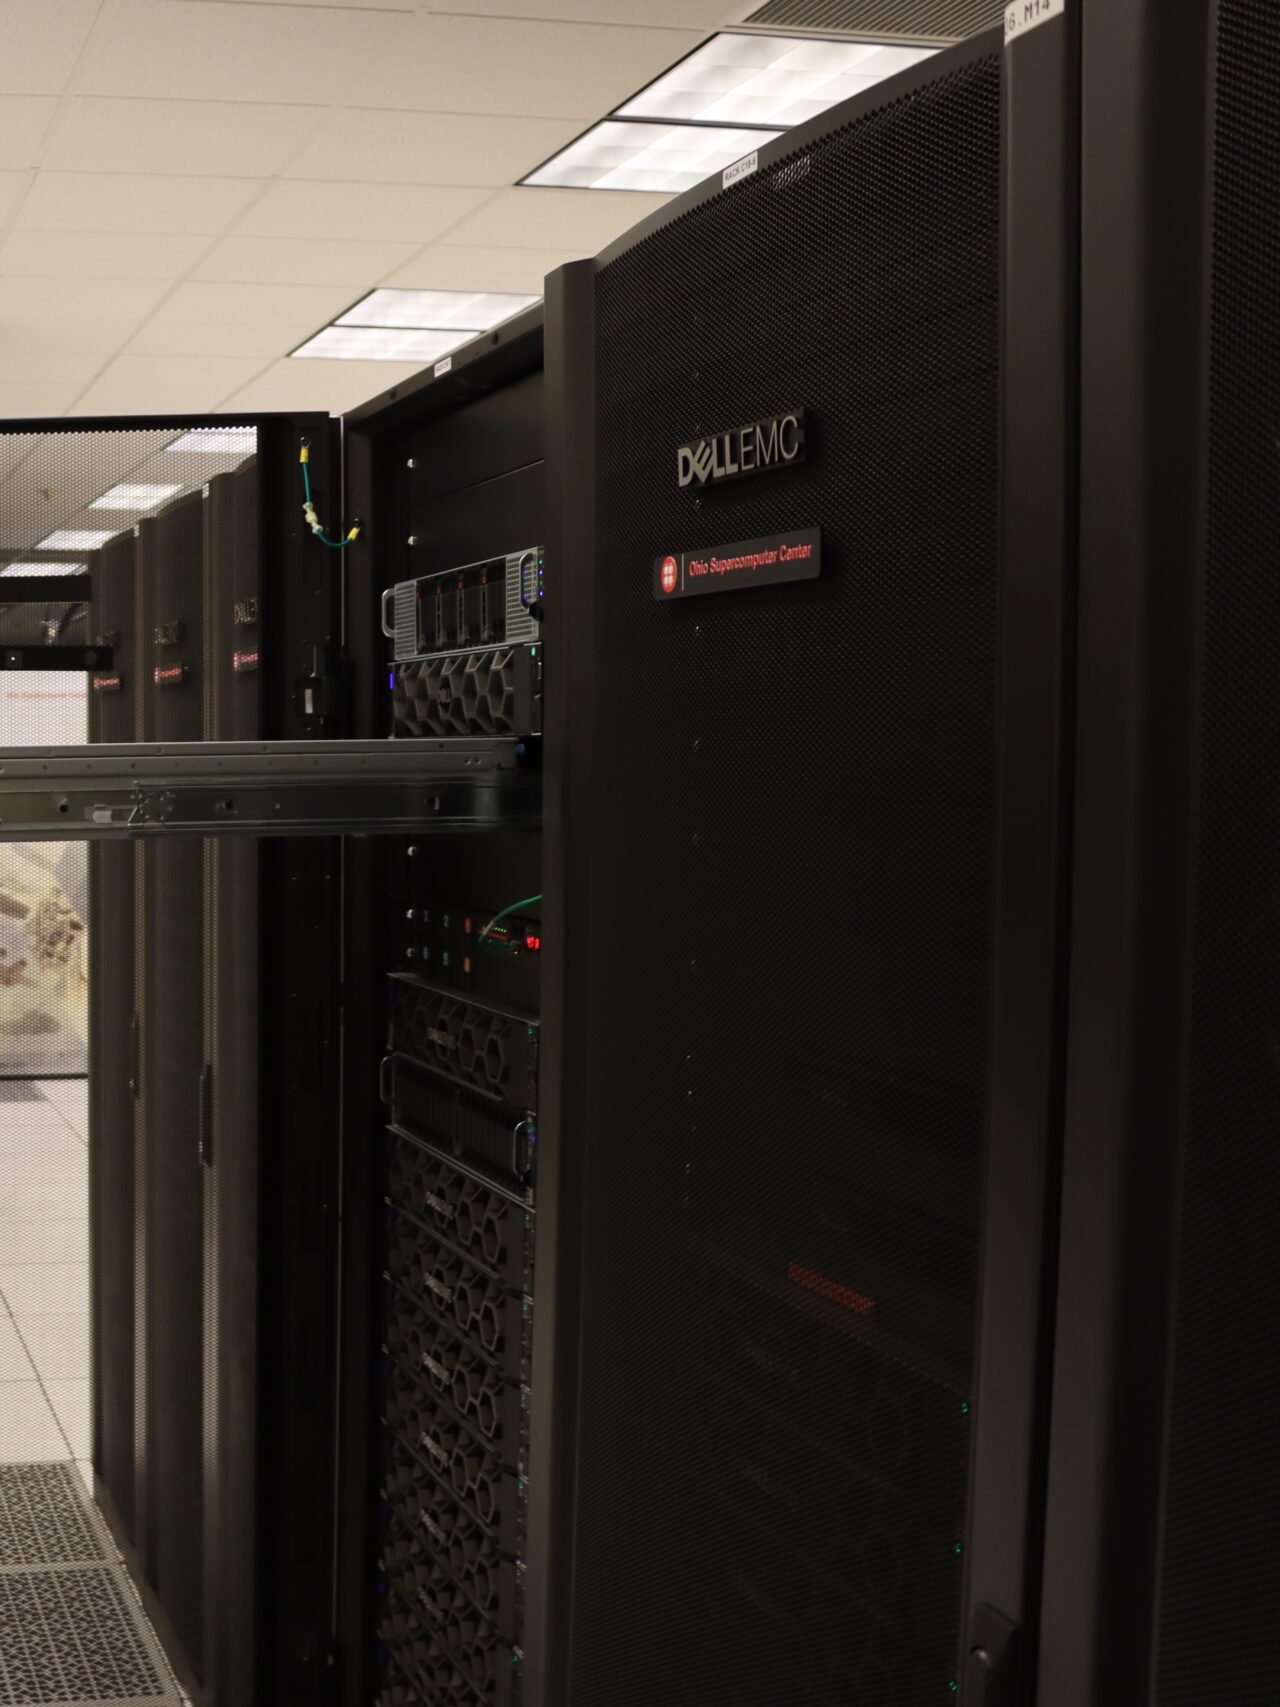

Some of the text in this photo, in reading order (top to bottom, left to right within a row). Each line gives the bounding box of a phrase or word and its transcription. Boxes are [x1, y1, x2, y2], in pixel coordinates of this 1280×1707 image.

[689, 544, 812, 577] Ohio Supercomputer Center
